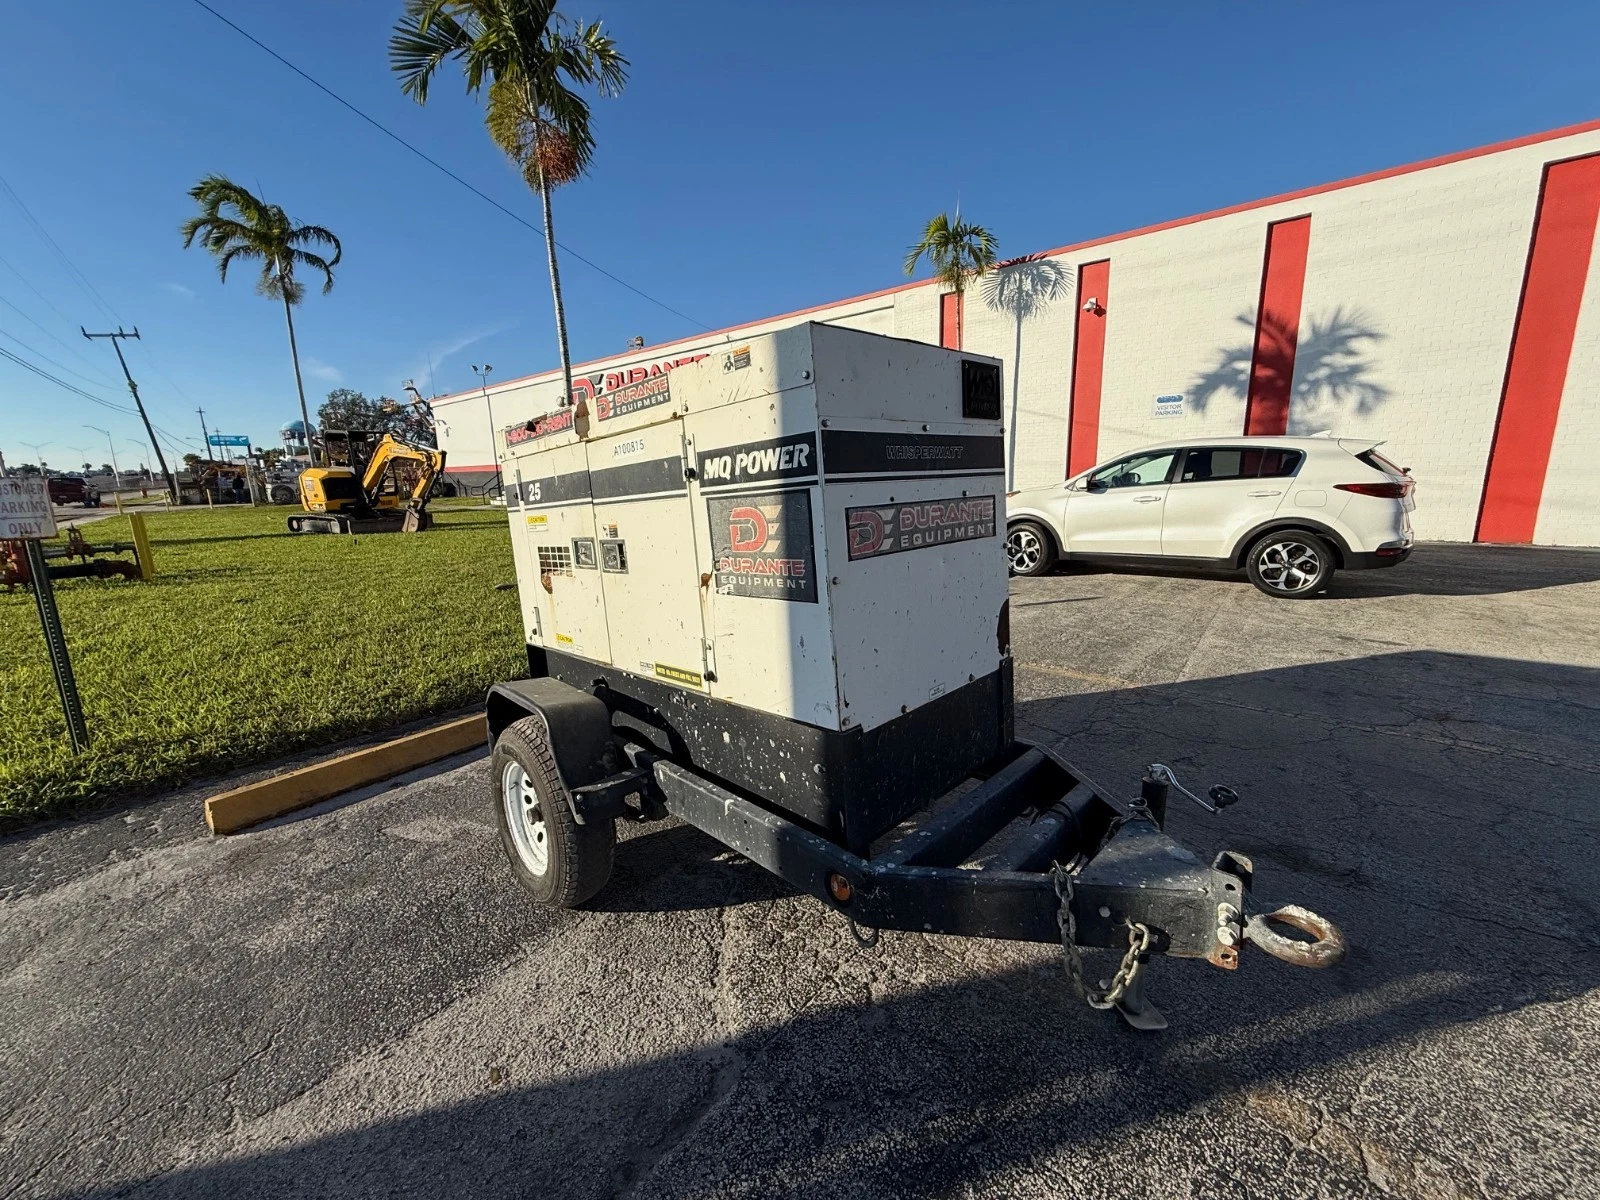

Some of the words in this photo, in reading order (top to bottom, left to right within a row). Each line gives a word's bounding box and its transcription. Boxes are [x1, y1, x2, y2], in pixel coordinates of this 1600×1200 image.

[615, 376, 668, 406] DURANTE
[616, 392, 669, 414] EQUIPMENT
[1157, 403, 1182, 411] VISITOR
[614, 439, 645, 456] A100815
[886, 445, 964, 459] WHISPERWATT
[703, 455, 732, 480] MQ
[735, 443, 810, 476] POWER
[528, 482, 541, 501] 25
[900, 500, 994, 531] DURANTE
[9, 522, 42, 535] ONLY
[900, 523, 994, 547] EQUIPMENT
[720, 557, 806, 577] DURANTE
[721, 576, 807, 589] EQUIPMENT
